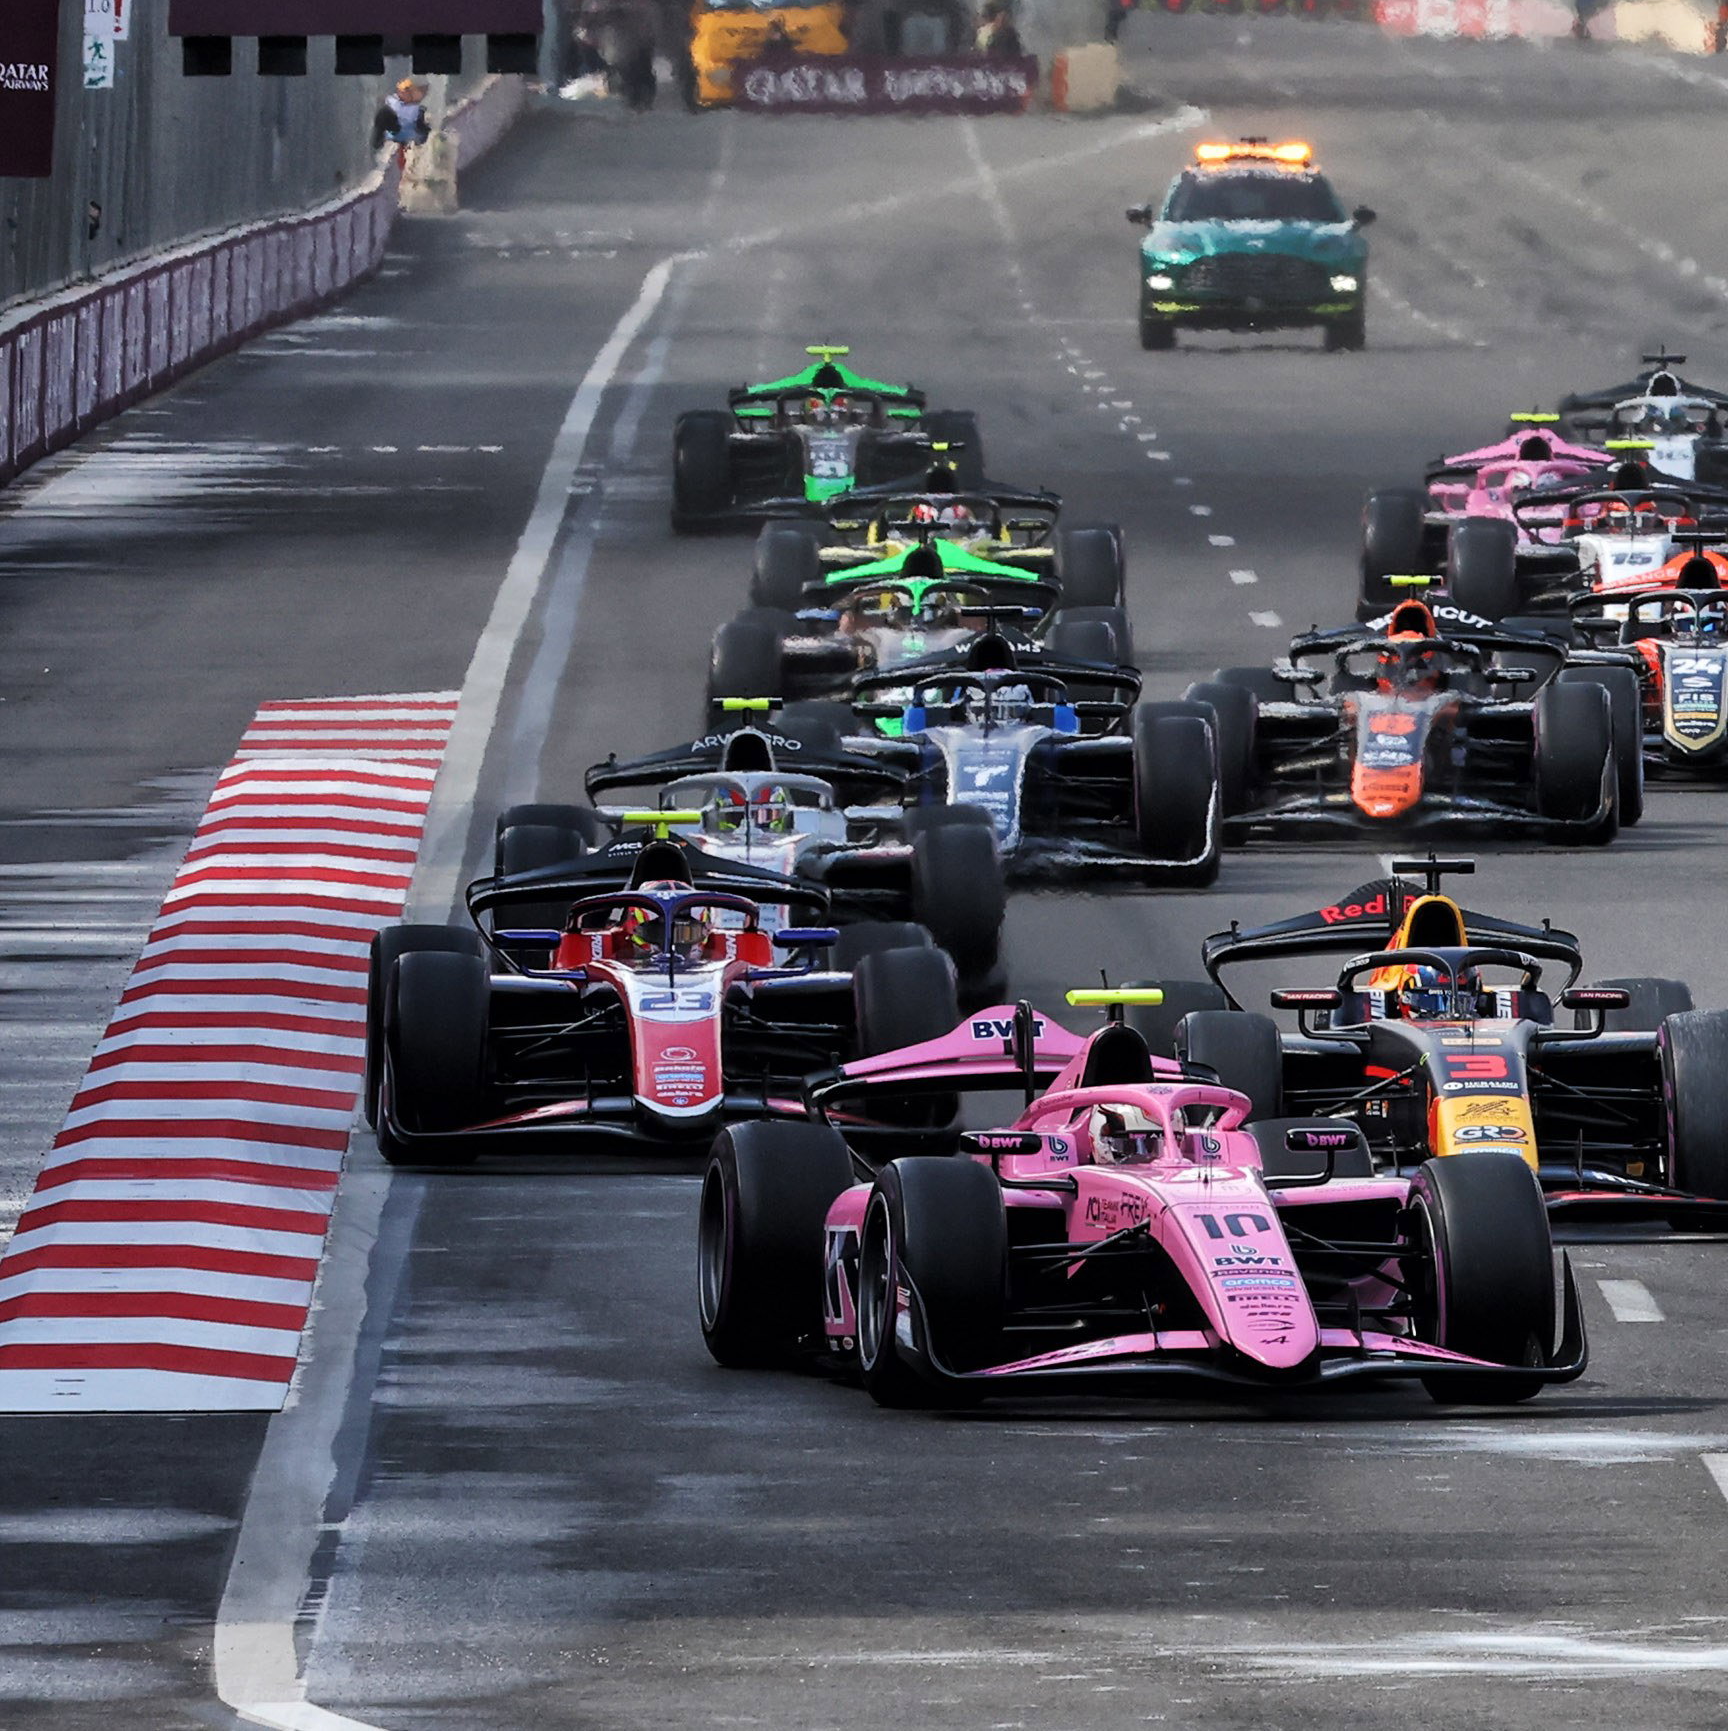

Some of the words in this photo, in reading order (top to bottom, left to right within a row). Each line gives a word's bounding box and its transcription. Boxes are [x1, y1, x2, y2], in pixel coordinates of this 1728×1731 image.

[955, 641, 1042, 655] WAMS
[1671, 658, 1723, 676] 24
[1319, 894, 1385, 925] Red
[639, 990, 716, 1011] 23
[971, 1019, 1047, 1041] BWT
[1445, 1054, 1509, 1079] 3
[991, 1136, 1023, 1149] BWT
[1318, 1133, 1347, 1146] BWT
[1193, 1212, 1273, 1240] 10
[1214, 1256, 1283, 1267] BWT
[1224, 1278, 1292, 1286] aramco
[1227, 1294, 1300, 1303] PIRELLI
